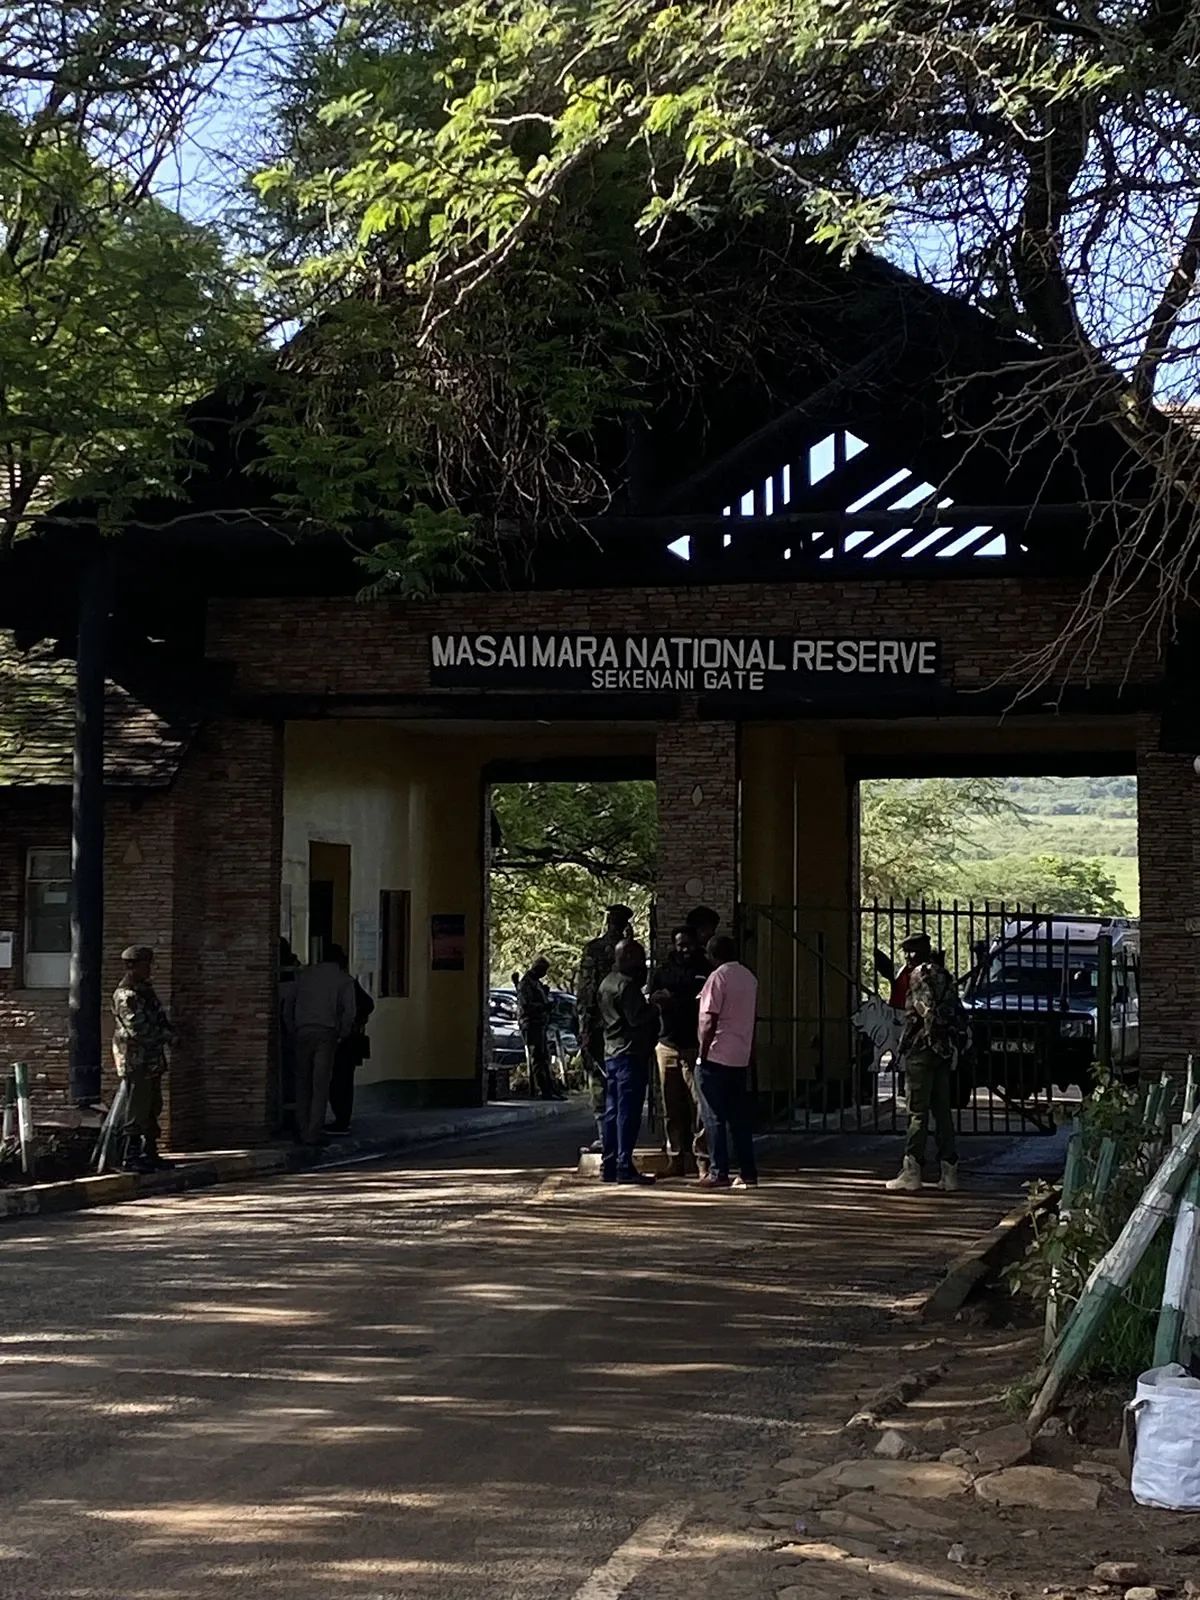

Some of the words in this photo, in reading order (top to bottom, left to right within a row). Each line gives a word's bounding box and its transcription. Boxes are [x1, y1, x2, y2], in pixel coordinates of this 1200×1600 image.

[431, 635, 526, 669] MASAI
[531, 636, 619, 669] MARA
[625, 637, 787, 672] NATIONAL
[791, 640, 938, 675] RESERVE
[591, 668, 695, 690] SEKENANI
[702, 670, 766, 692] GATE
